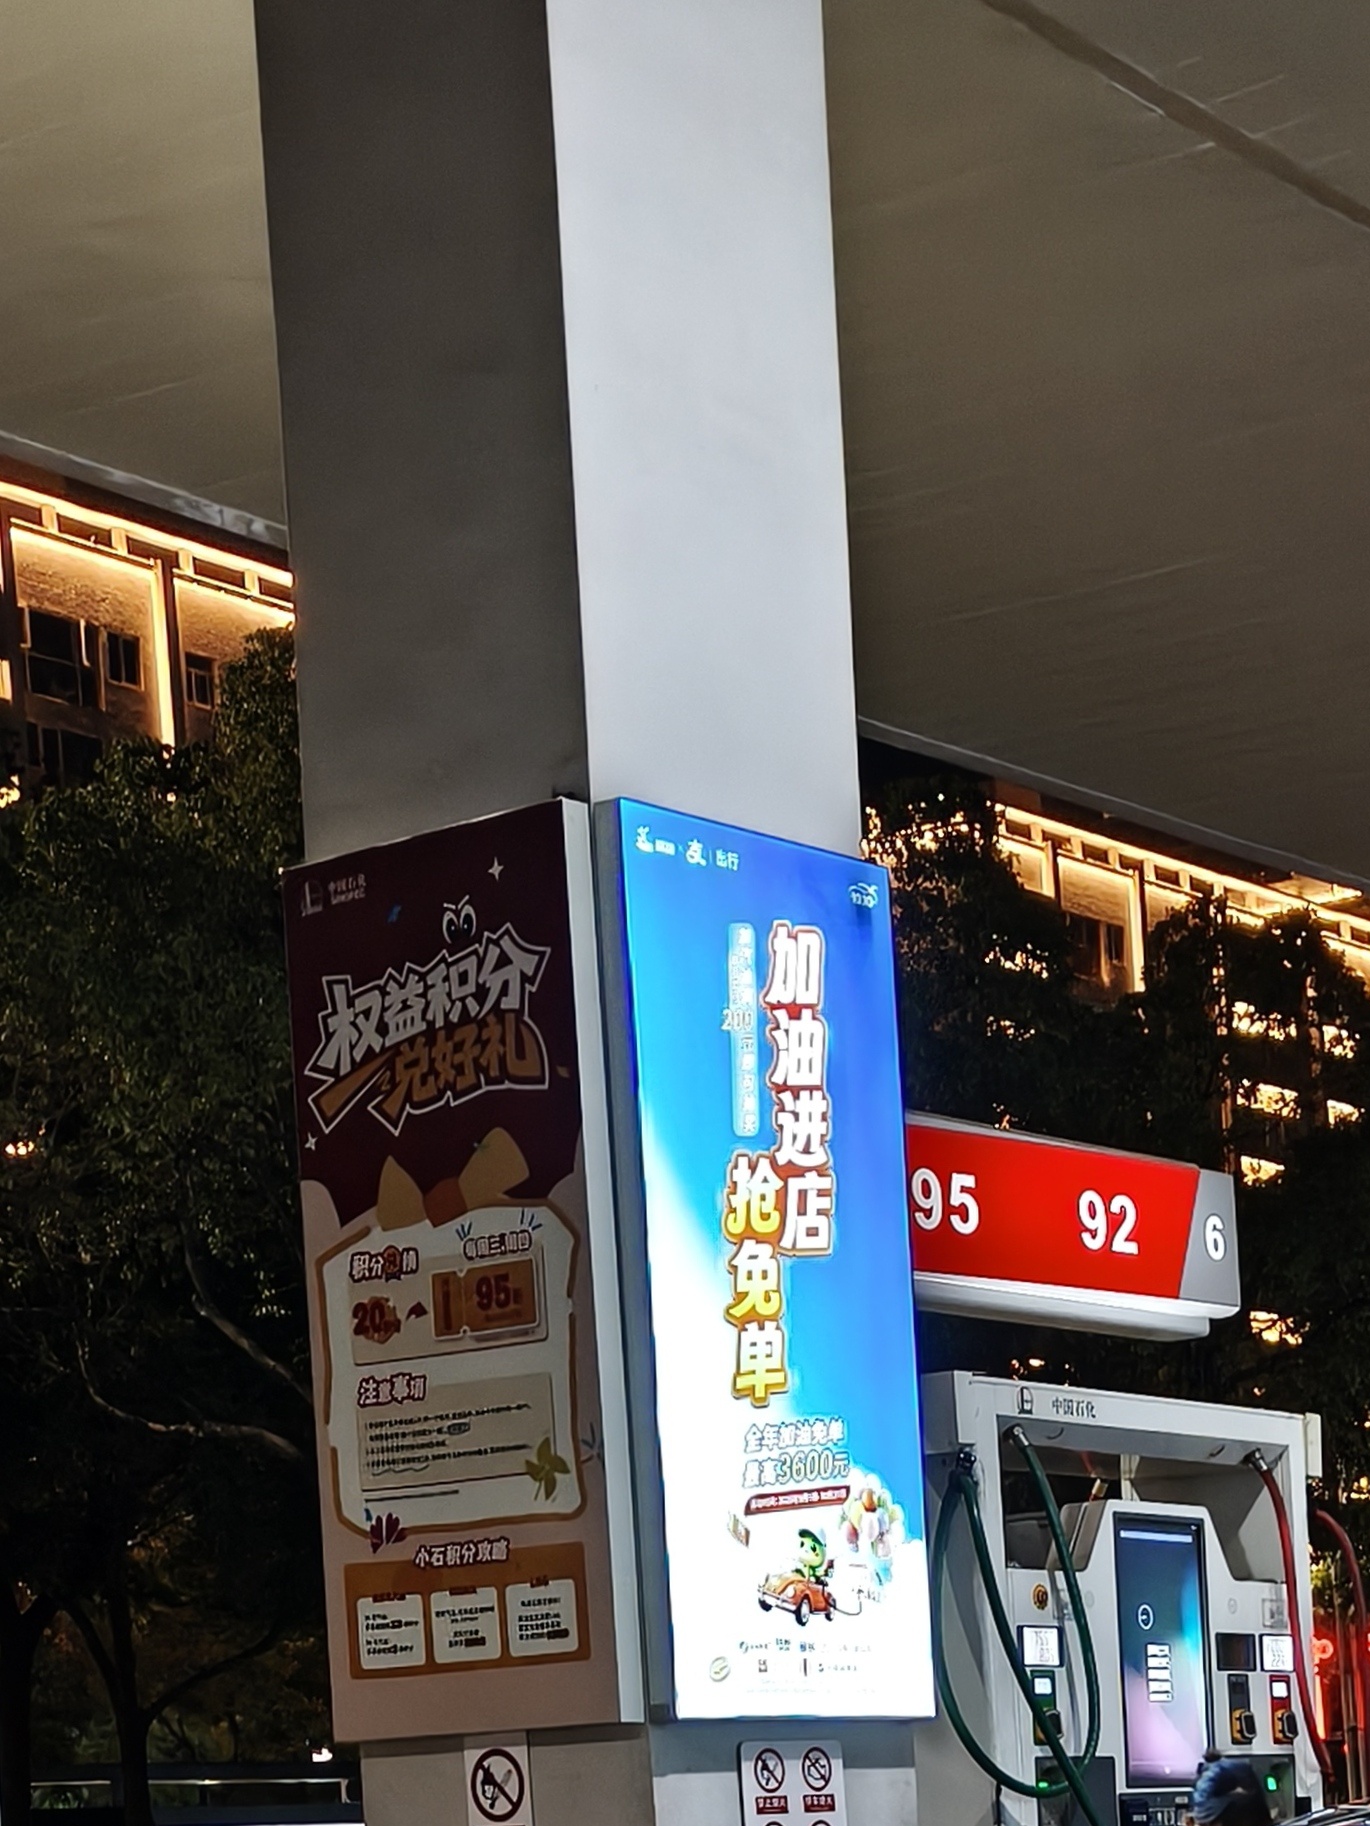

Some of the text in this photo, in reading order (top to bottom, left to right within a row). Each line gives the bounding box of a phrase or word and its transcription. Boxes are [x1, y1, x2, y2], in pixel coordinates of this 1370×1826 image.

[317, 934, 540, 1076] 权益积分
[764, 923, 835, 1254] 加油进店
[724, 1154, 788, 1401] 抢免单
[911, 1168, 1227, 1262] 95 92 6
[1052, 1397, 1096, 1419] 中国石化
